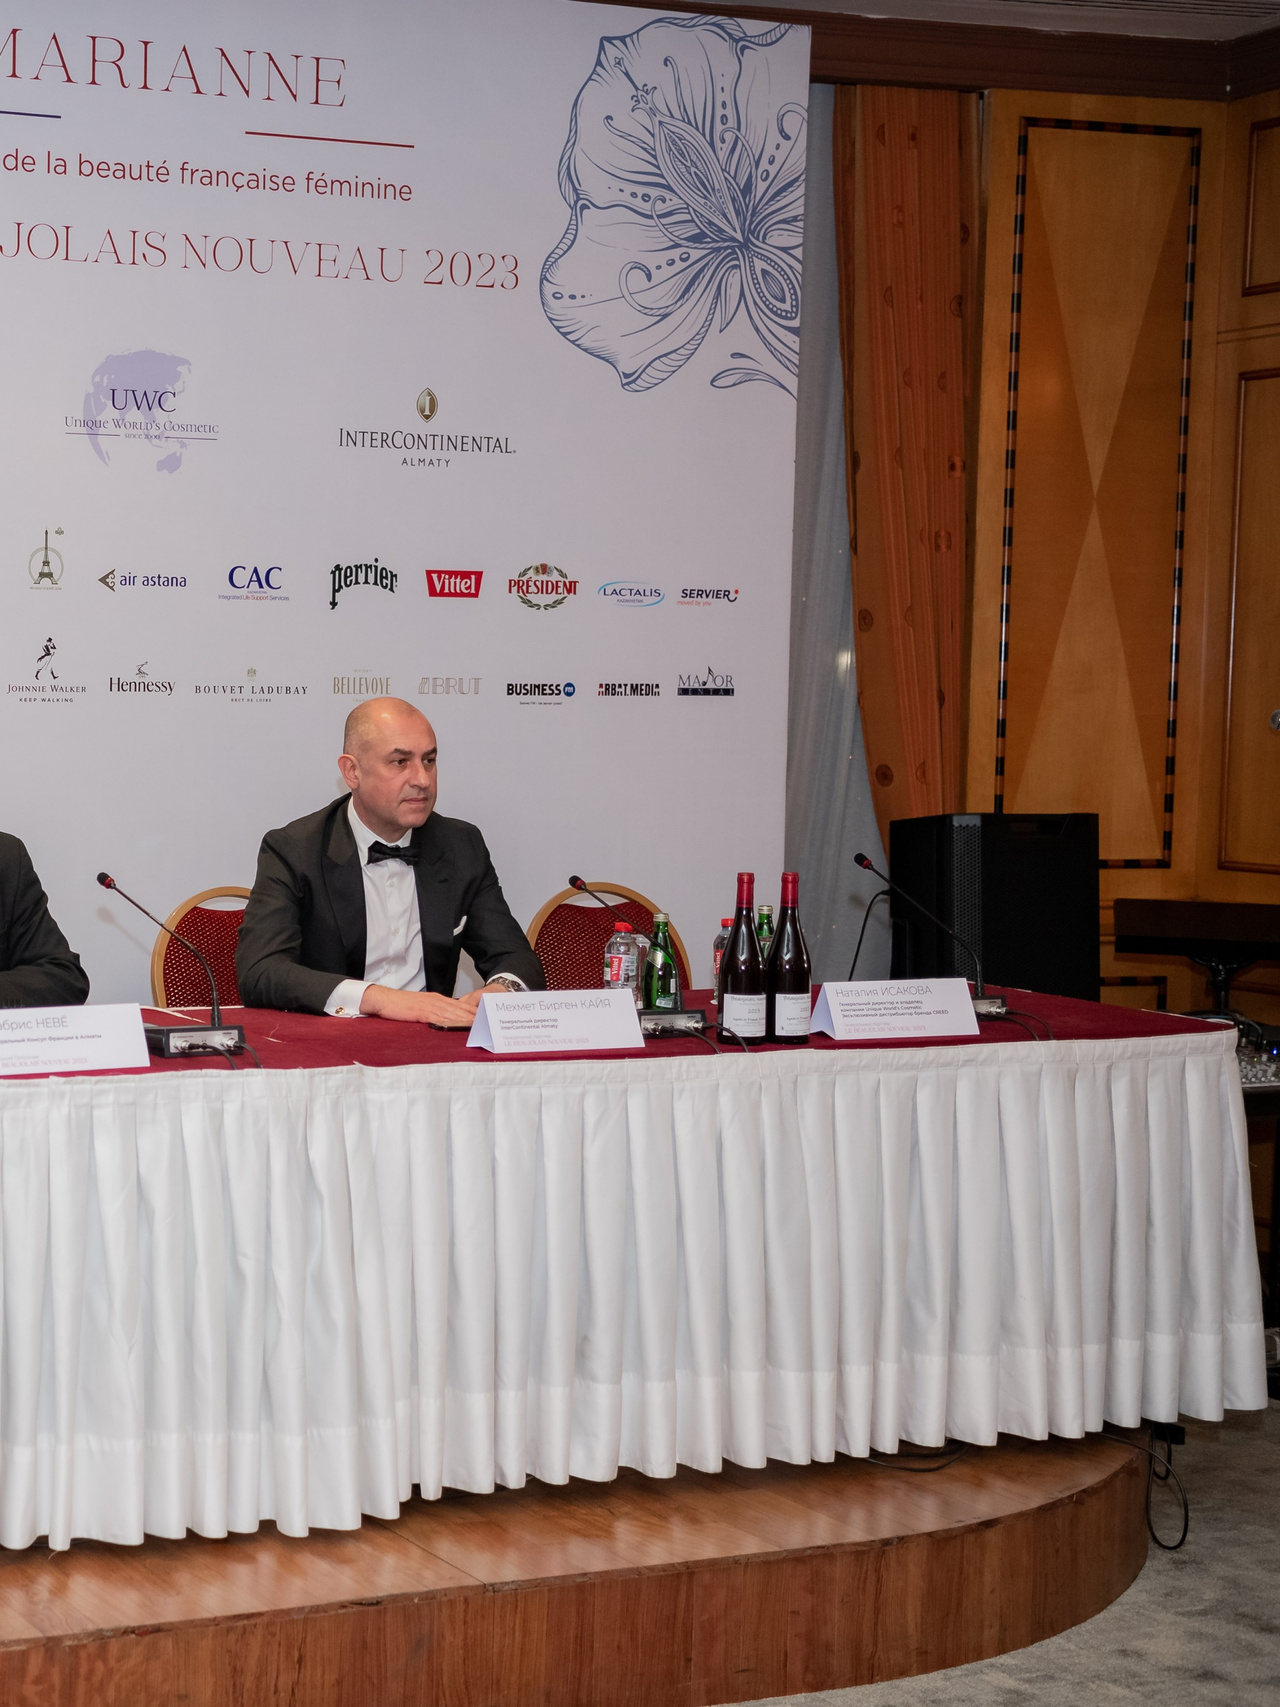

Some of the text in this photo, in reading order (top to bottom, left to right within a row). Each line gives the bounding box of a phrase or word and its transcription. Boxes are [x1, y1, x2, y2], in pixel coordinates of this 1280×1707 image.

[2, 147, 37, 174] de
[45, 151, 70, 176] la
[78, 153, 171, 184] beauté
[179, 160, 297, 196] française
[305, 170, 414, 203] féminine
[181, 232, 408, 284] NOUVEAU
[422, 248, 521, 291] 2023
[109, 388, 177, 413] UWC
[401, 457, 451, 468] ALMATY
[119, 571, 187, 588] air astana
[228, 565, 282, 590] CAC
[431, 573, 477, 594] Vittel
[508, 576, 580, 598] PRÉSIDENT
[602, 587, 662, 598] LACTALIS
[681, 588, 734, 601] SERVIER
[6, 684, 87, 695] JOHNNIE WALKER
[109, 677, 176, 696] Hennessy
[195, 685, 308, 695] BOUVET LADUBAY
[333, 676, 391, 695] BELLEVOYE
[507, 683, 562, 697] BUSINESS
[598, 683, 660, 697] ARBAT.MEDIA
[835, 985, 932, 998] Наталия ИСАКОВА
[495, 996, 611, 1013] Мехмет Бирген КАЙЯ
[36, 1015, 68, 1029] НЕВЁ
